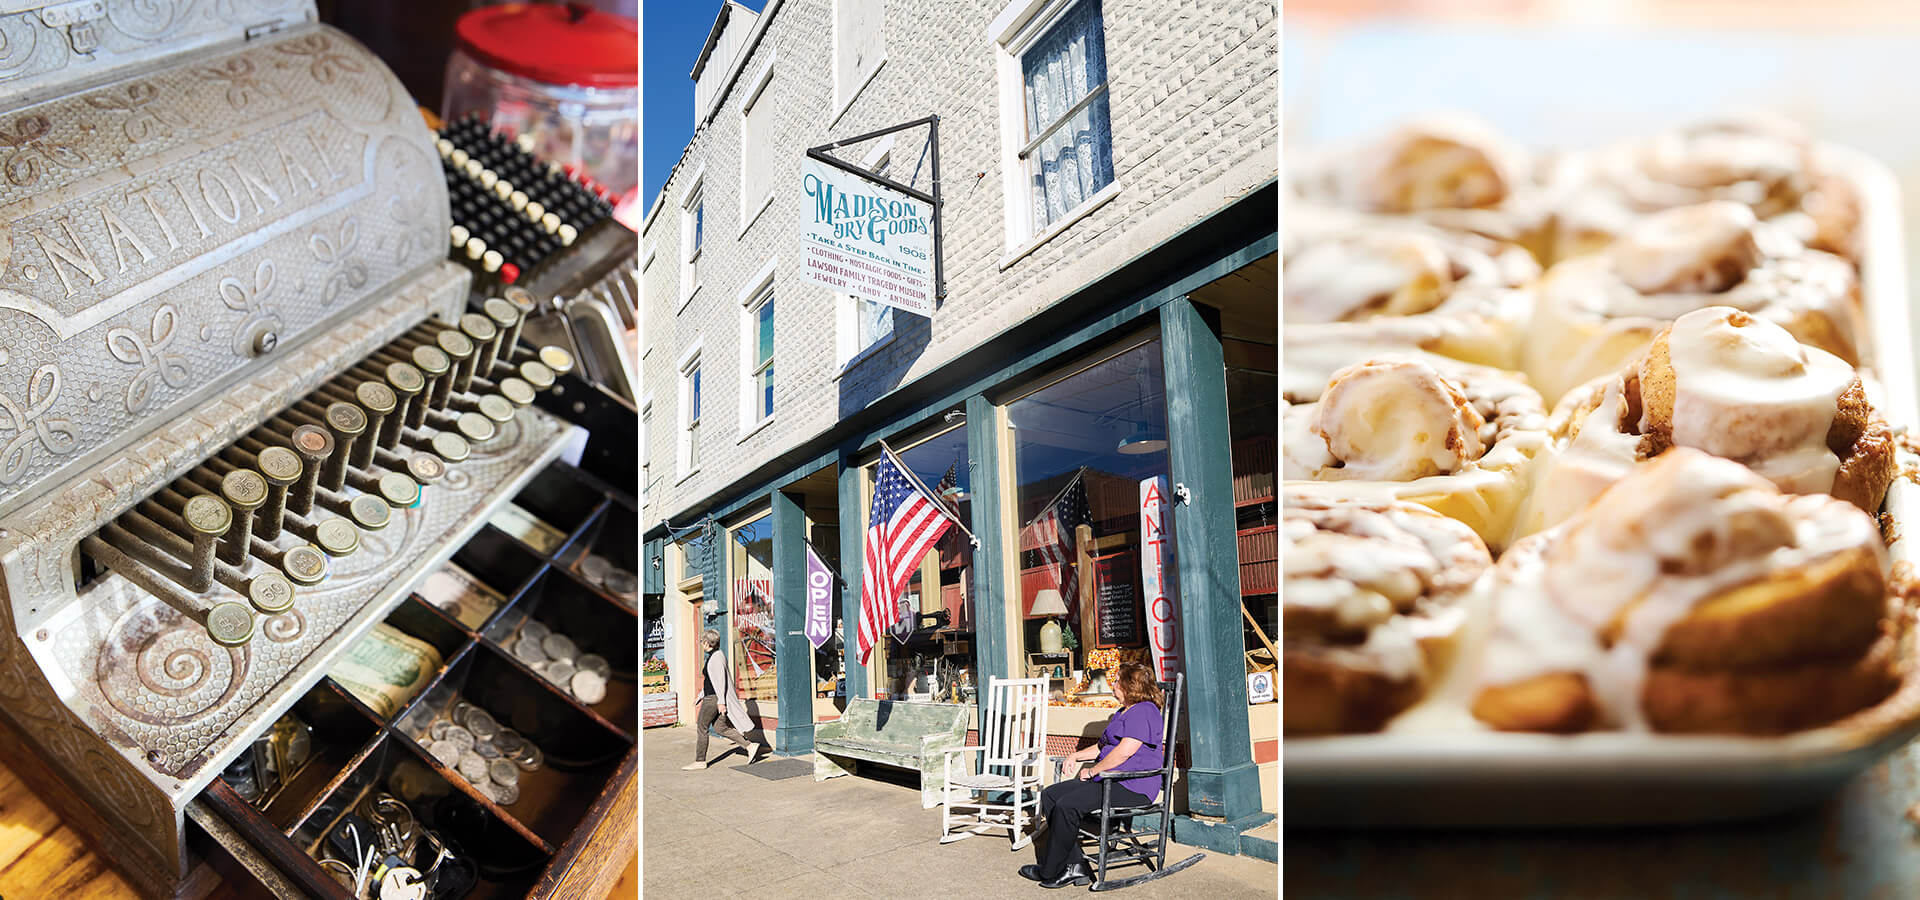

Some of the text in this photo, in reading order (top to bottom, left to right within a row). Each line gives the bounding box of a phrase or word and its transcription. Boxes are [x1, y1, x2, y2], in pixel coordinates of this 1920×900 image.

[29, 126, 348, 300] NATIONAL
[803, 173, 917, 226] MADISON
[833, 215, 928, 246] DRY GOODS
[811, 232, 835, 247] TAKE
[845, 244, 867, 255] STEP
[868, 251, 891, 264] BACK
[902, 263, 922, 275] TIME
[811, 246, 923, 288] CLOTHING NOSTALGIC FOODS GIFTS
[899, 245, 927, 260] 1908
[807, 257, 927, 301] LAWSON FAMILY TRAGEDY MUSEUM
[813, 272, 922, 310] JEWELRY CANDY ANTIQUES
[1143, 481, 1178, 683] ANTIQUE
[809, 570, 830, 638] OPEN
